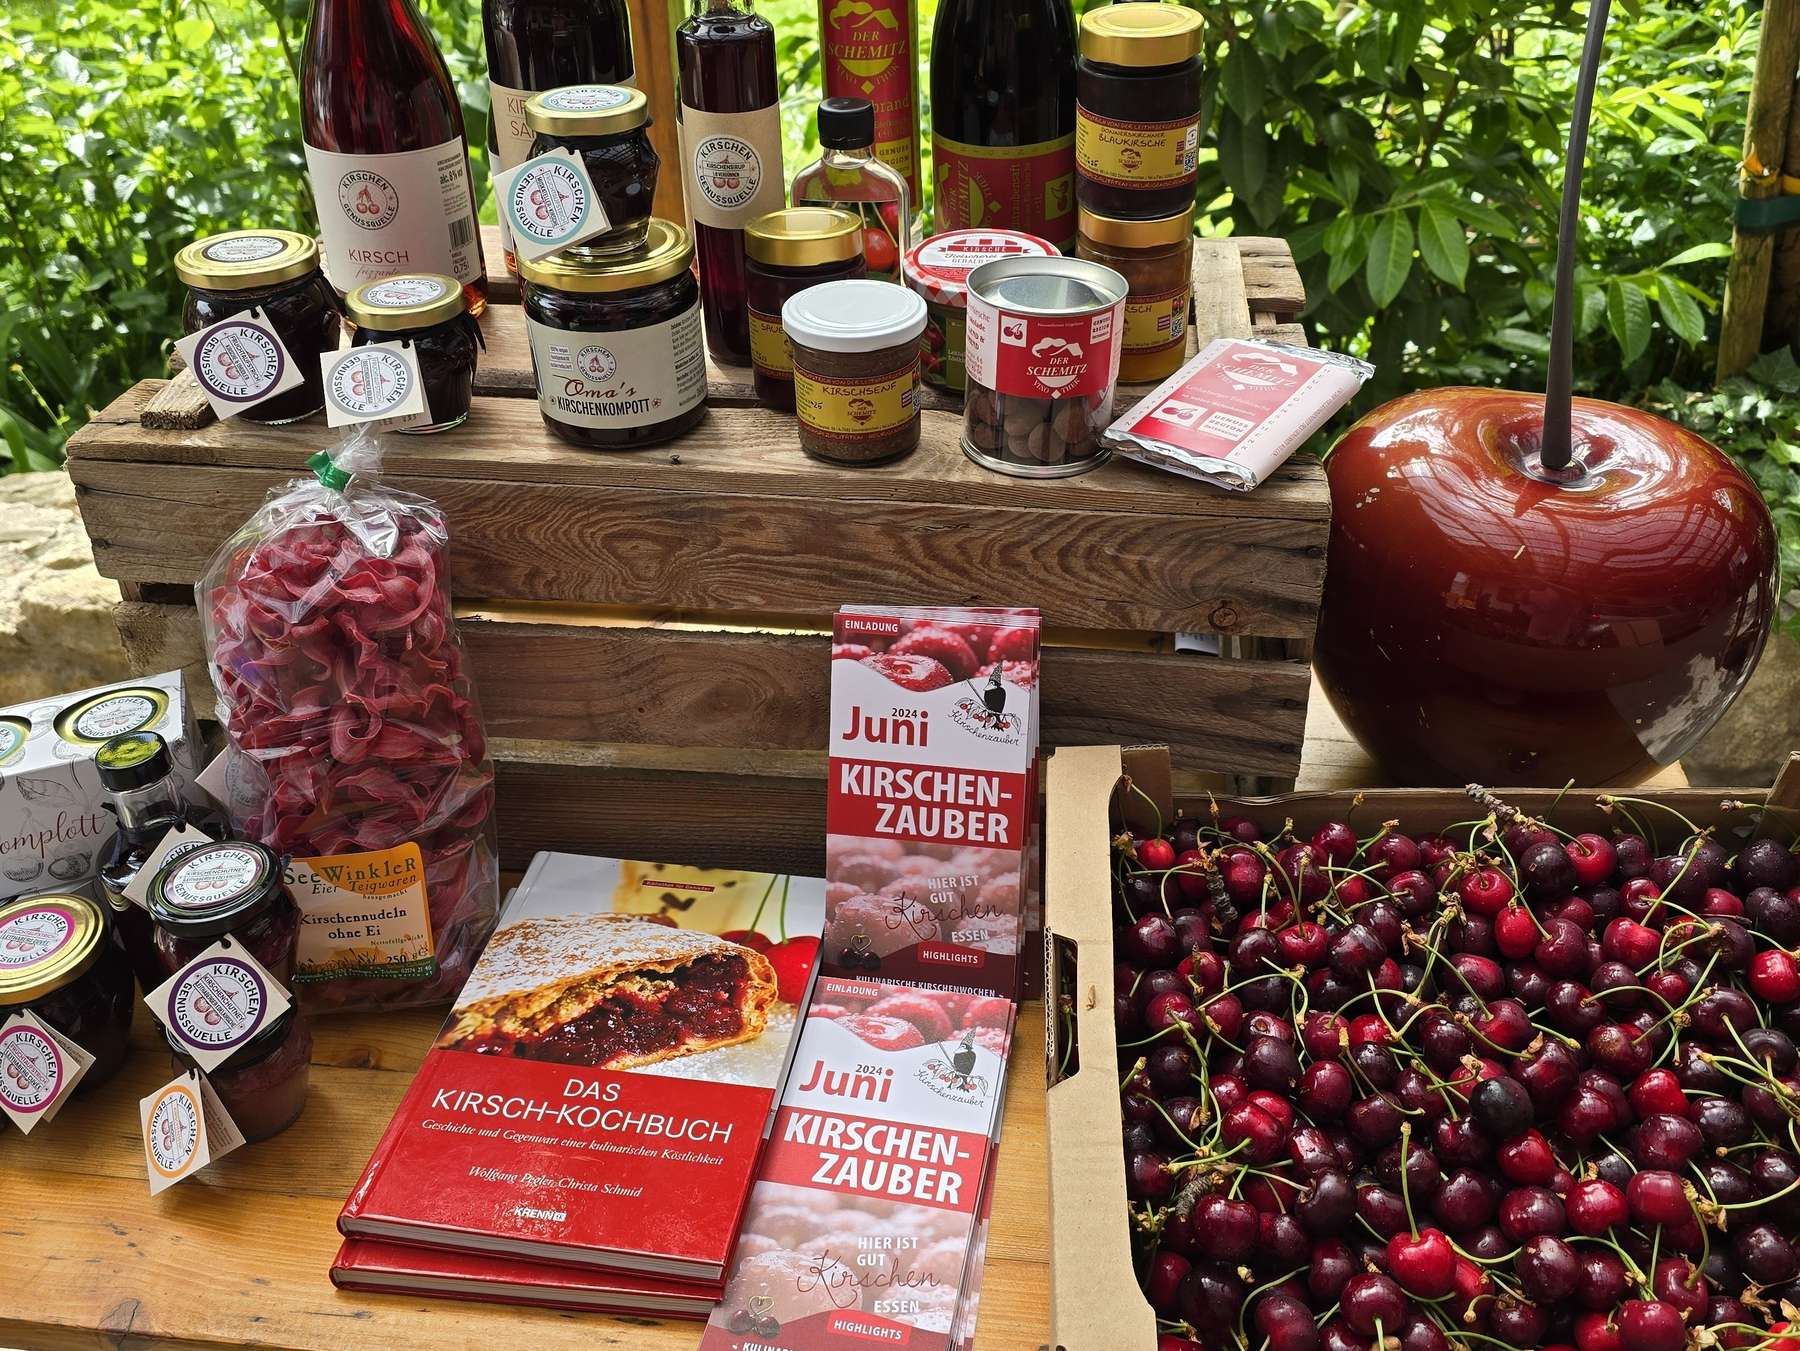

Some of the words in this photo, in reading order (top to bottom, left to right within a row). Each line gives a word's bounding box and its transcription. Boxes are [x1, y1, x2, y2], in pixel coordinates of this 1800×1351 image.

[853, 31, 880, 41] DER
[828, 41, 906, 59] SCHEMITZ
[1098, 133, 1167, 148] BLAUKIRSCHE
[700, 141, 753, 161] KIRSCHEN
[342, 173, 389, 191] KIRSCHEN
[699, 174, 757, 204] GENUSSQUELLE
[554, 165, 585, 224] KIRSCHEN
[515, 172, 554, 238] GENUSSQUELLE
[343, 203, 396, 228] GENUSSQUELLE
[348, 248, 409, 264] KIRSCH
[240, 328, 277, 380] KIRSCHEN
[581, 347, 611, 358] KIRSCHEN
[1049, 357, 1069, 365] DER
[201, 336, 249, 396] GENUSSQUELLE
[580, 366, 614, 381] GENUSSQUELLE
[1026, 363, 1088, 377] SCHEMITZ
[333, 355, 366, 411] GENUSSQUELLE
[380, 355, 406, 404] KIRSCHEN
[555, 376, 636, 399] Oma's
[822, 381, 897, 397] KIRSCHSENF
[557, 396, 650, 417] KIRSCHENKOMPOTT
[845, 620, 898, 633] EINLADUNG
[87, 698, 146, 716] KIRSCHEN
[891, 707, 918, 719] 2024
[842, 705, 929, 747] Juni
[840, 763, 1012, 808] KIRSCHEN-
[875, 802, 1009, 844] ZAUBER
[188, 851, 253, 869] KIRSCHEN
[174, 878, 248, 902] GENUSSQUELLE
[311, 883, 338, 895] Eier
[349, 874, 417, 892] Teigwaren
[928, 876, 958, 889] HIER
[960, 874, 980, 887] IST
[929, 892, 954, 904] GUT
[14, 913, 67, 933] KIRSCHEN
[300, 906, 408, 925] Kirschennudeln
[885, 891, 1002, 941] Kirschen
[328, 928, 361, 939] ohne
[365, 925, 381, 936] Ei
[951, 929, 988, 943] ESSEN
[387, 954, 407, 965] 250
[922, 950, 979, 964] HIGHLIGHTS
[203, 974, 245, 1022] KIRSCHENCHUTNEY
[213, 965, 260, 1016] KIRSCHEN
[826, 983, 878, 997] EINLADUNG
[918, 981, 996, 998] KIRSCHENWOCHEN
[176, 982, 233, 1042] GENUSSQUELLE
[15, 1033, 57, 1079] KIRSCHEN
[855, 1064, 883, 1076] 2024
[563, 1078, 621, 1102] DAS
[799, 1060, 895, 1103] Juni
[179, 1094, 198, 1156] KIRSCHEN
[431, 1088, 734, 1144] KIRSCH-KOCHBUCH
[151, 1100, 174, 1170] GENUSSQUELLE
[421, 1119, 476, 1136] Geschichte
[477, 1127, 501, 1139] und
[503, 1129, 559, 1148] Gegenwart
[560, 1138, 588, 1149] einer
[588, 1139, 658, 1159] kulinarischen
[660, 1147, 724, 1166] Köstlichkeit
[783, 1112, 970, 1166] KIRSCHEN-
[468, 1165, 518, 1184] Wolfgang
[557, 1177, 599, 1193] Christa
[600, 1182, 643, 1198] Schmid
[811, 1152, 963, 1205] ZAUBER
[514, 1207, 555, 1221] KRENN
[857, 1237, 892, 1249] HIER
[896, 1237, 919, 1249] IST
[856, 1253, 886, 1266] GUT
[797, 1249, 941, 1309] Kirschen
[873, 1300, 920, 1313] ESSEN
[833, 1320, 902, 1340] HIGHLIGHTS
